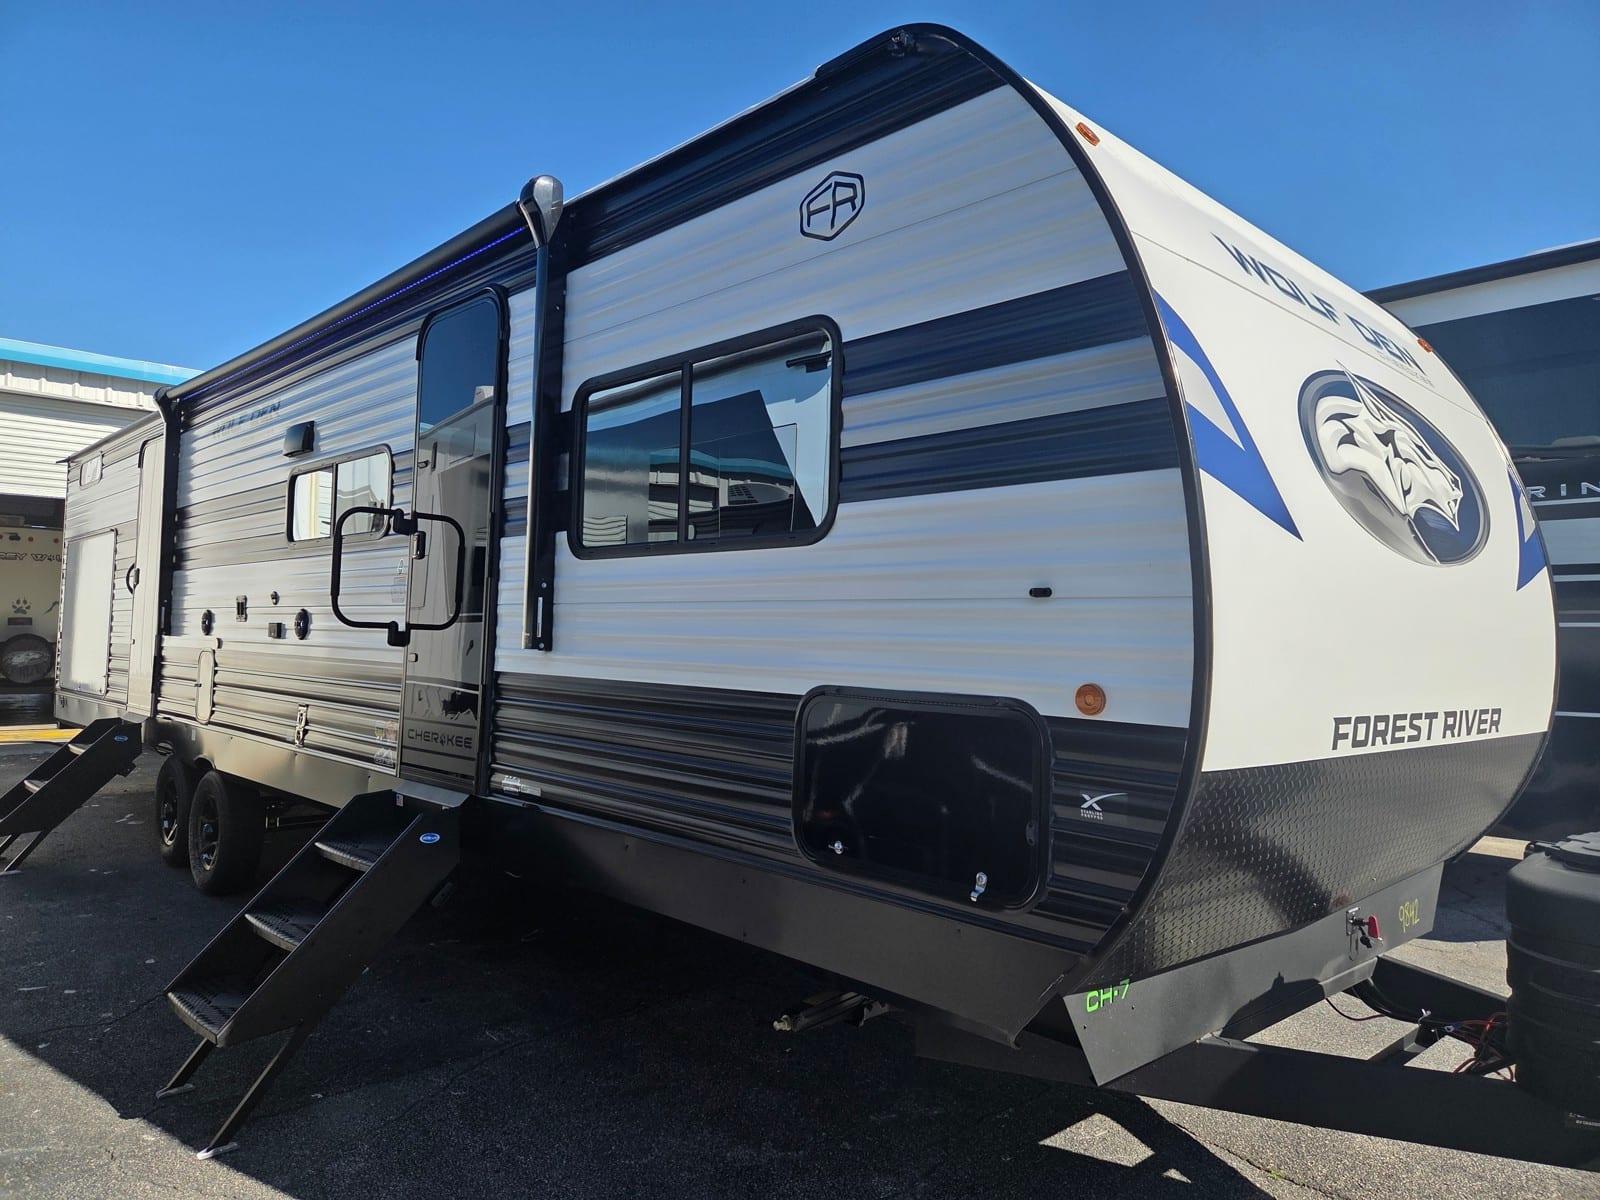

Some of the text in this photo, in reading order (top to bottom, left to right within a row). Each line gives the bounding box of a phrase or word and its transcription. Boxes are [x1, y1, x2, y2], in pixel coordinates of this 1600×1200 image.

[1210, 231, 1341, 326] WOLF
[1343, 312, 1427, 376] DEN
[407, 728, 473, 749] CHEROKEE
[1331, 707, 1502, 751] FOREST RIVER
[1086, 978, 1130, 1013] CH-7
